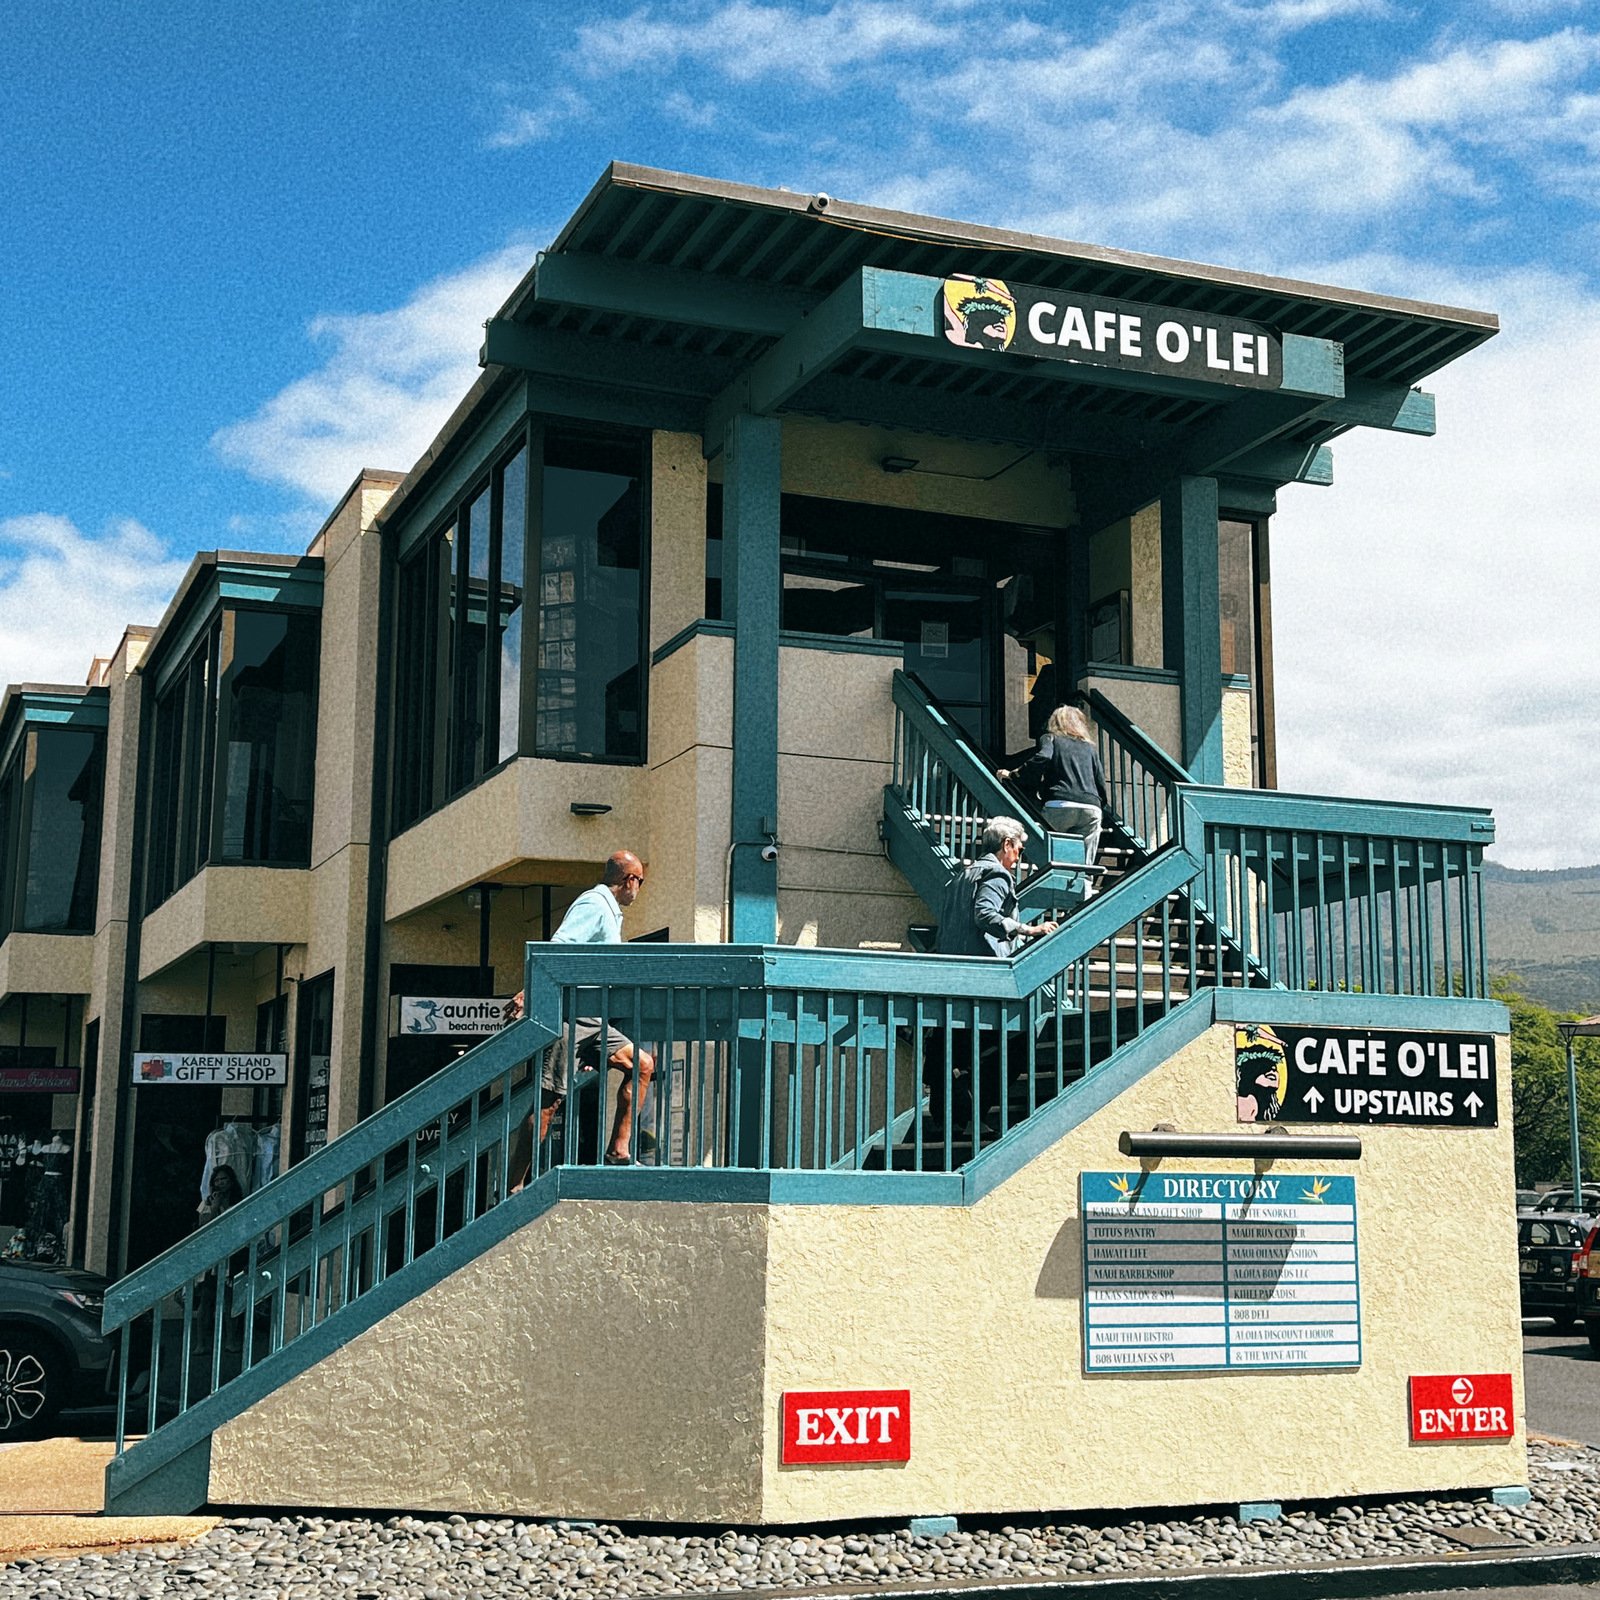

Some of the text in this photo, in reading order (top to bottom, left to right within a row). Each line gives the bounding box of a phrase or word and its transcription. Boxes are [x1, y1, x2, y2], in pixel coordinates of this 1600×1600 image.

[1027, 301, 1269, 376] CAFE O'LEI
[443, 1002, 501, 1019] auntie
[448, 1021, 479, 1031] beach
[181, 1057, 271, 1067] KAREN ISLAND
[1294, 1037, 1490, 1080] CAFE O'LEI
[175, 1067, 276, 1081] GIFT SHOP
[1334, 1088, 1454, 1117] UPSTAIRS
[1163, 1178, 1280, 1199] DIRECTORY
[1129, 1207, 1159, 1218] ISLAND
[1181, 1208, 1203, 1218] SHOP
[1231, 1208, 1297, 1218] AUNTIE SNORKEL
[1124, 1228, 1156, 1238] PANTRY
[1231, 1228, 1306, 1239] MAUI RUN CENTER
[1129, 1248, 1148, 1258] LIFE
[1231, 1248, 1318, 1258] MAUI OHANA FASHION
[1094, 1269, 1175, 1279] MAUI BARBERSHOP
[1233, 1269, 1309, 1279] ALOHA BOARDS LLC
[1123, 1290, 1150, 1300] SALON
[1151, 1291, 1159, 1300] &
[1159, 1290, 1175, 1300] SPA
[1233, 1289, 1297, 1299] KIHEI PARADISE
[1234, 1309, 1270, 1320] 808 DELI
[1095, 1331, 1174, 1343] MAUI THAI BISTRO
[1235, 1329, 1334, 1340] ALOHA DISCOUNT LIQUOR
[1095, 1352, 1175, 1364] 808 WELLNESS SPA
[1235, 1349, 1309, 1361] & THE WINE ATTIC
[795, 1406, 900, 1446] EXIT
[1418, 1407, 1509, 1434] ENTER
